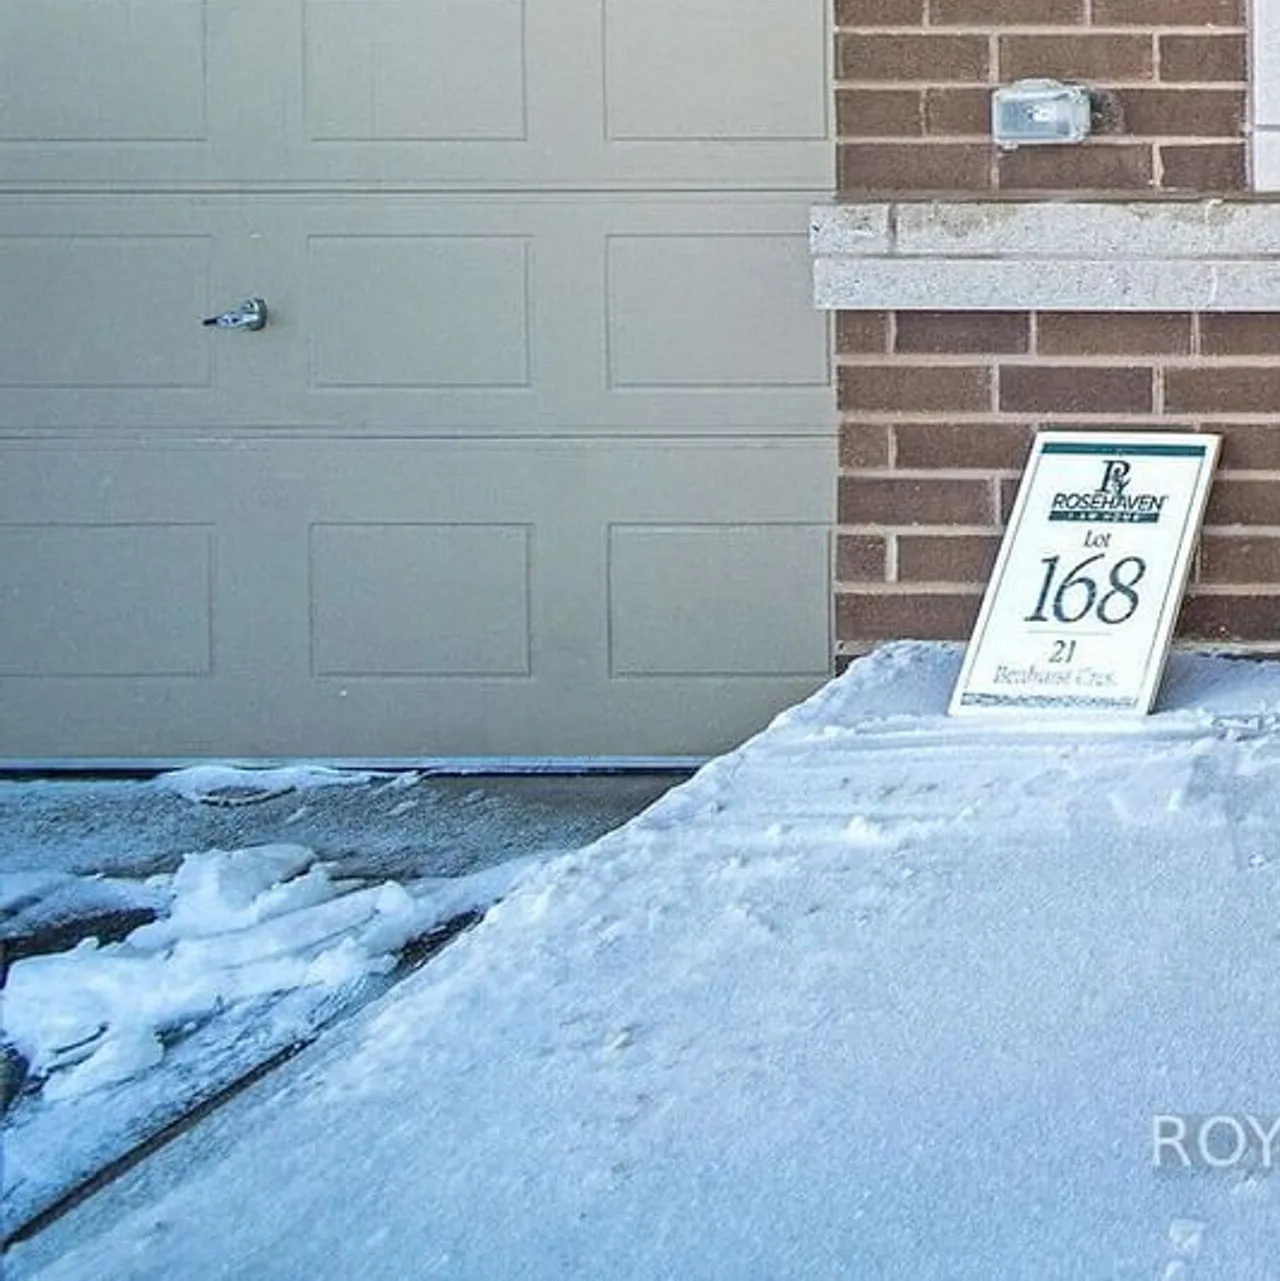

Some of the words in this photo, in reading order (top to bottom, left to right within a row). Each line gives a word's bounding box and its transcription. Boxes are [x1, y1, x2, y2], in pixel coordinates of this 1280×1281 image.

[1051, 492, 1165, 510] ROSEHAVEN
[1083, 530, 1111, 548] Lot
[1023, 553, 1146, 625] 168
[1048, 640, 1076, 663] 21
